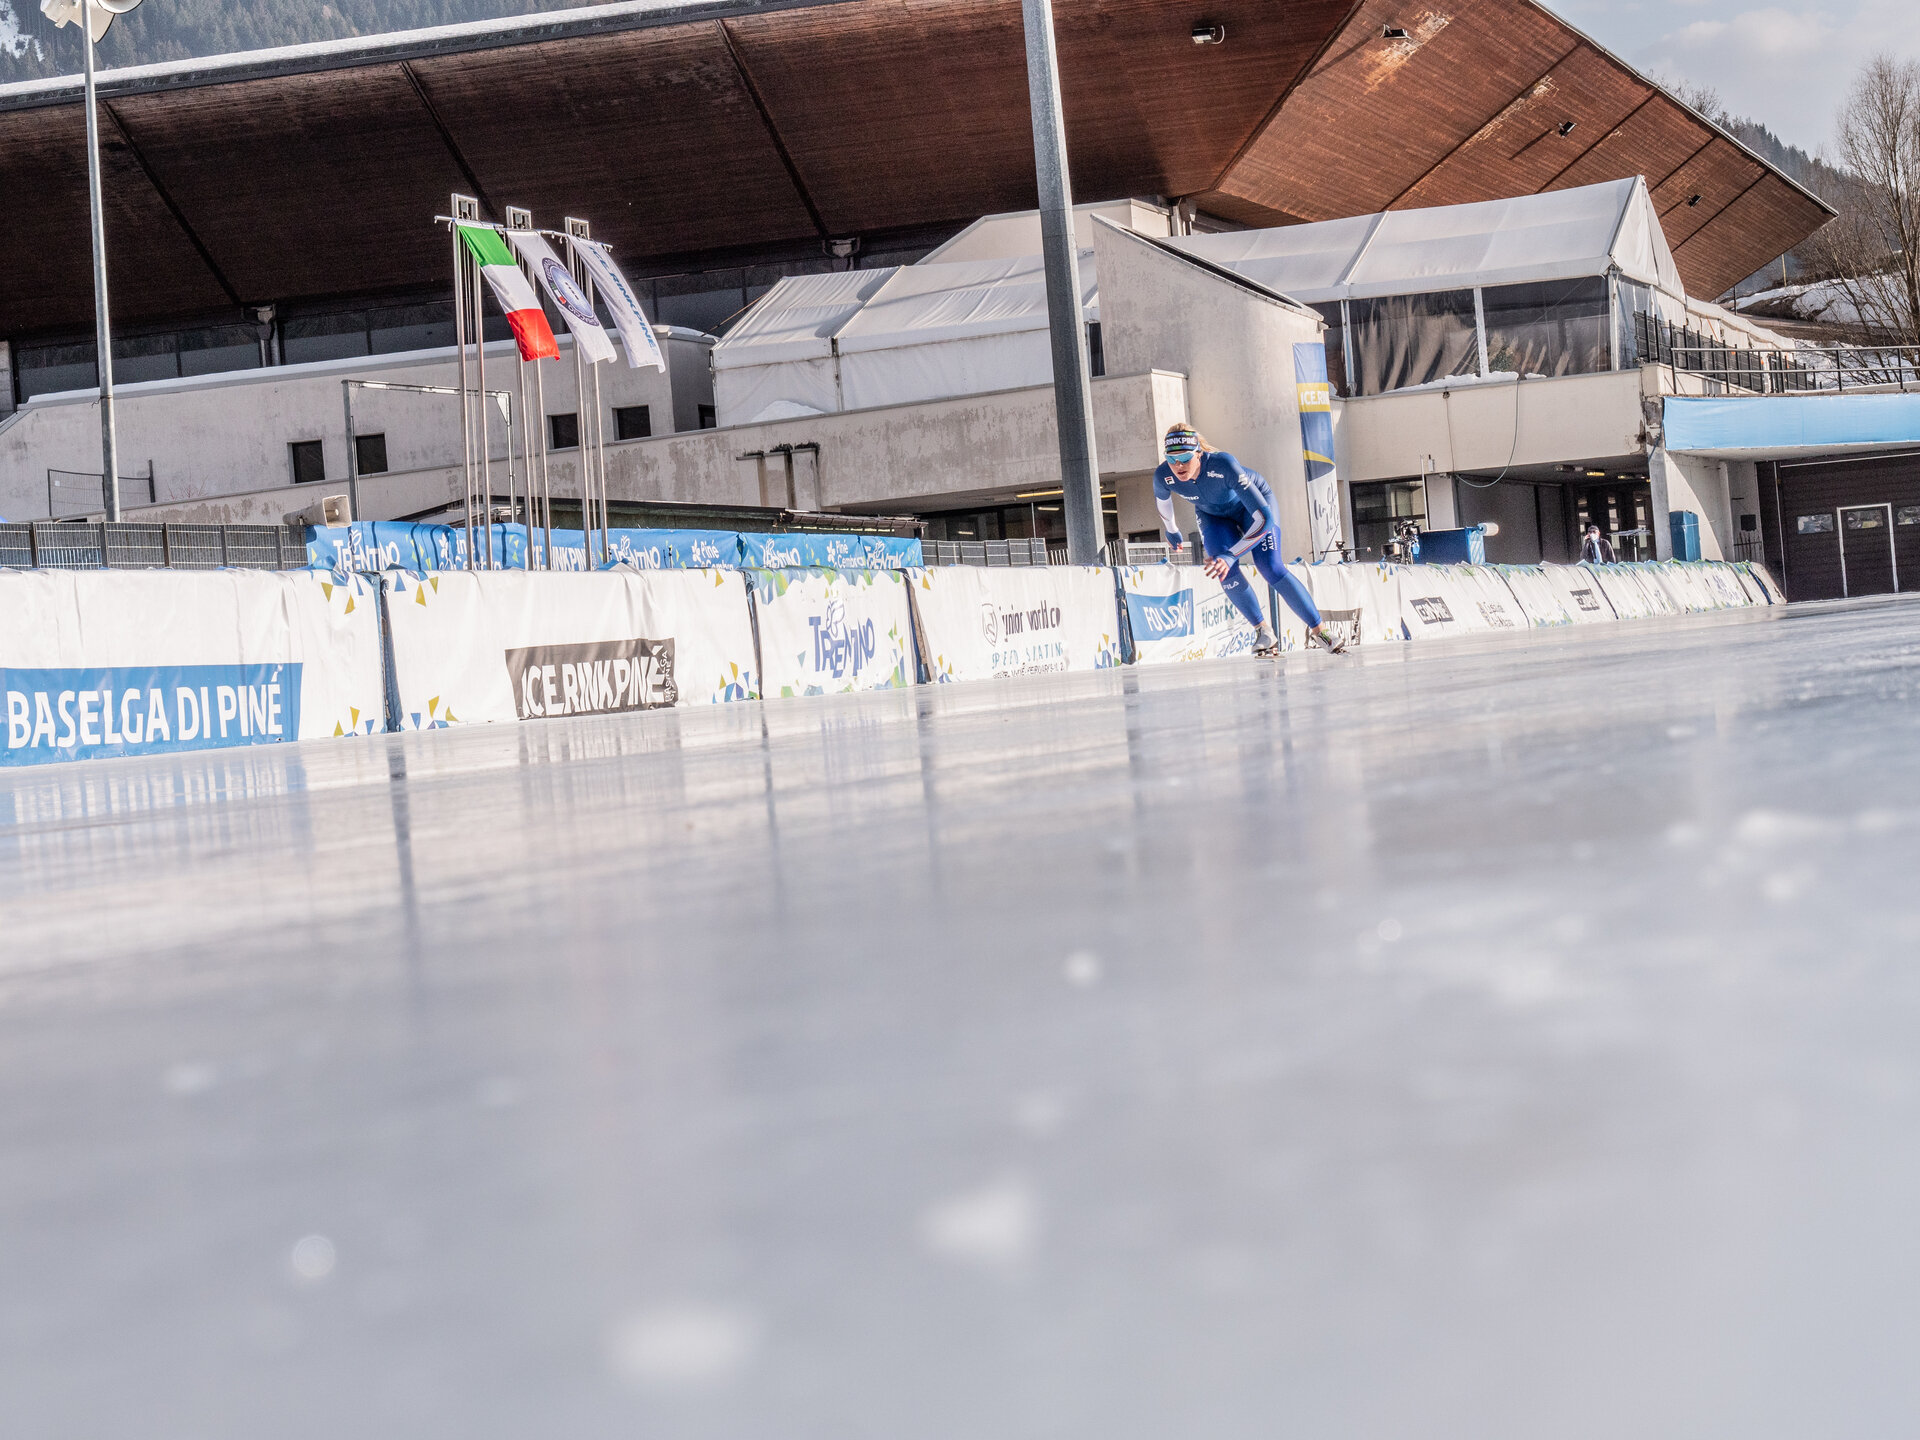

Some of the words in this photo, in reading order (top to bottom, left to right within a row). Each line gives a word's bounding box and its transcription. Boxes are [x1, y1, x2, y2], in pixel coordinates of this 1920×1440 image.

[1223, 581, 1239, 590] FILA
[6, 688, 171, 749] BASELGA
[175, 686, 211, 741] DI
[216, 664, 283, 738] PINÉ
